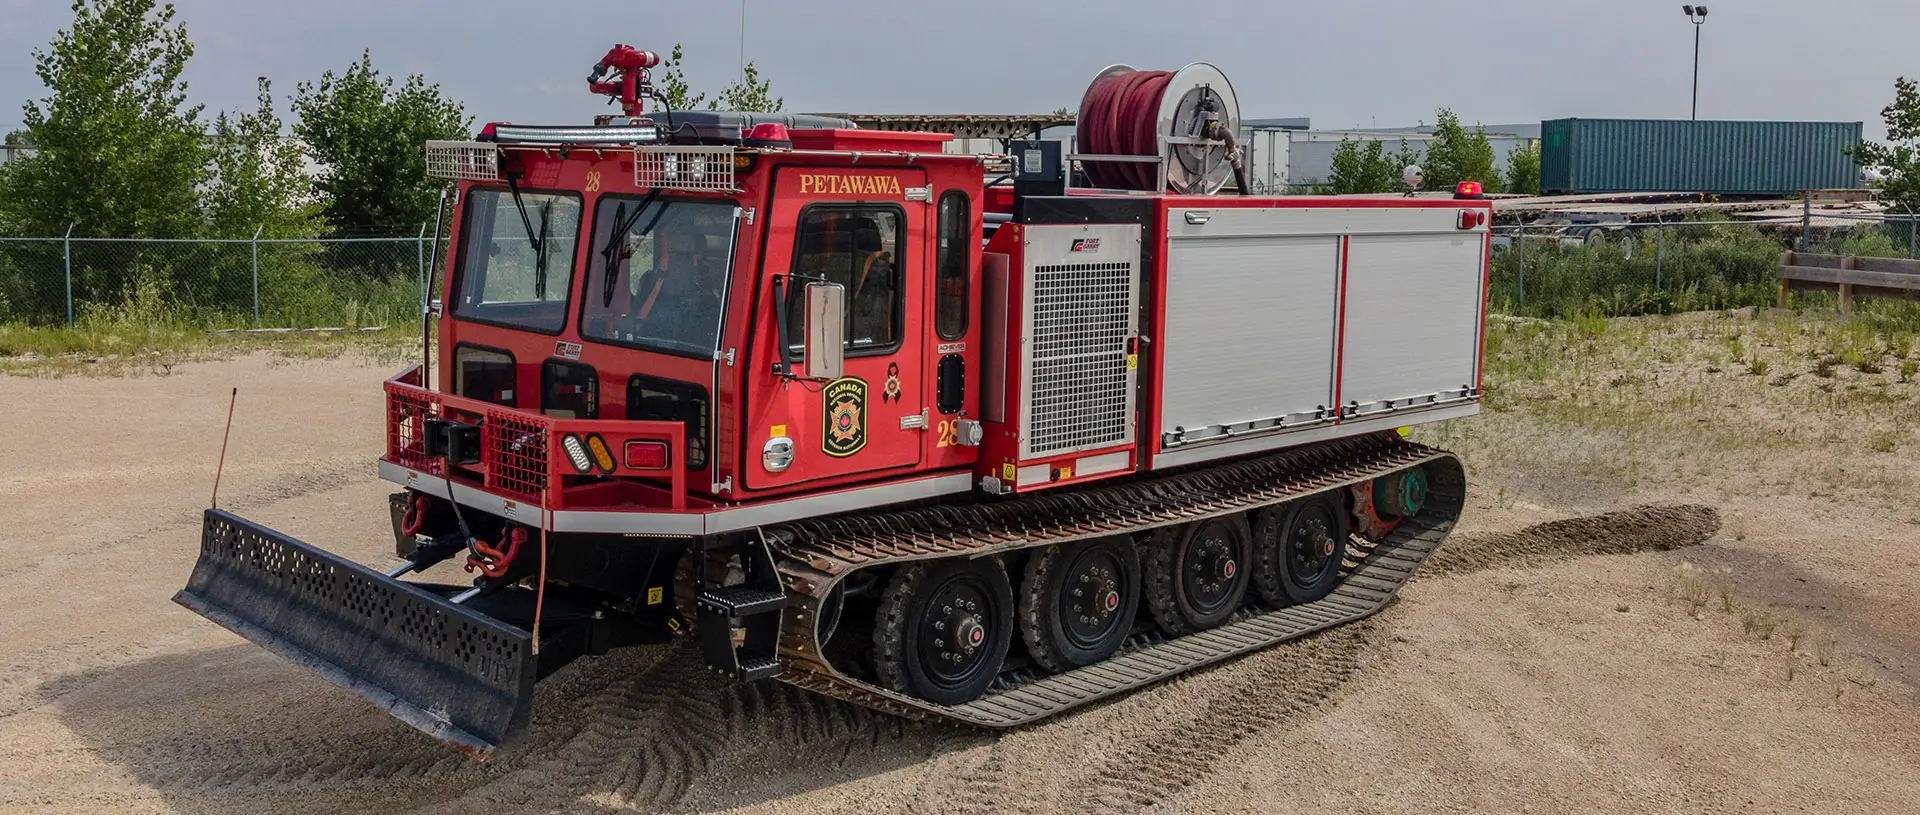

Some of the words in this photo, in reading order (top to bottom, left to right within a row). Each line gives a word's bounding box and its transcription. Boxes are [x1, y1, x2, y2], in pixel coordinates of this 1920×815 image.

[585, 171, 600, 191] 28
[800, 174, 902, 194] PETAWAWA
[829, 384, 862, 398] CANADA
[937, 419, 958, 448] 28
